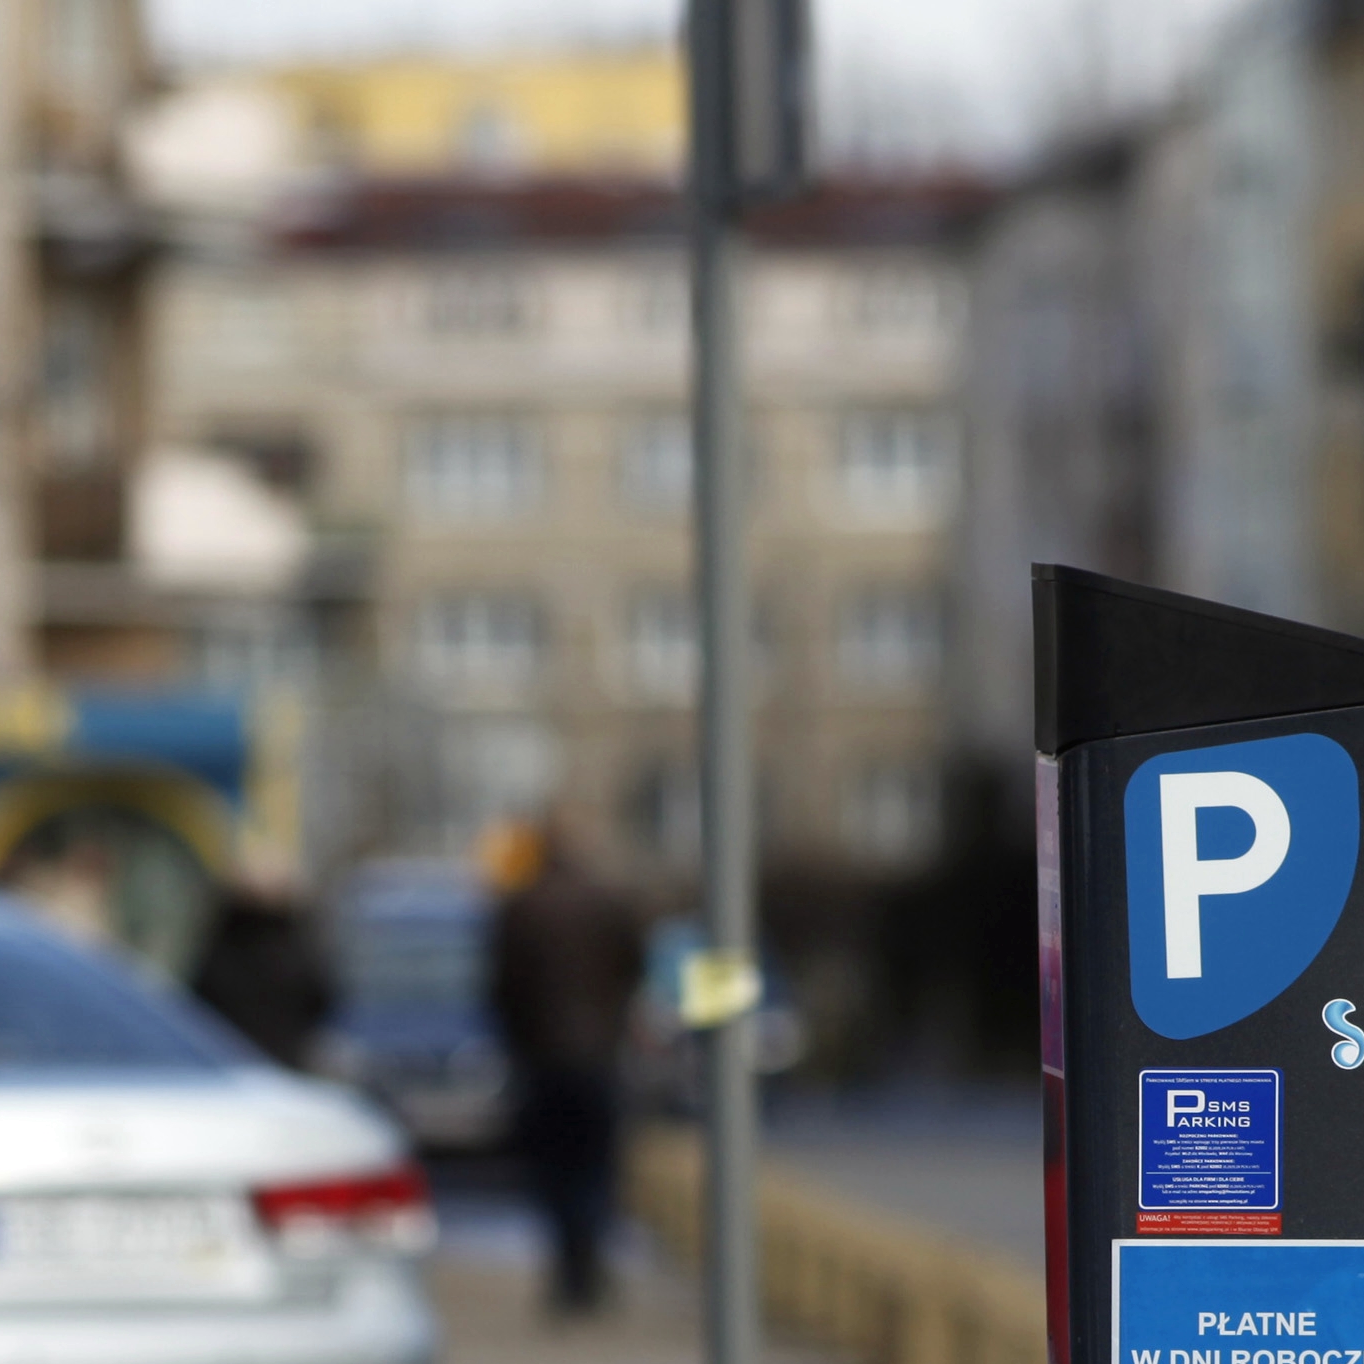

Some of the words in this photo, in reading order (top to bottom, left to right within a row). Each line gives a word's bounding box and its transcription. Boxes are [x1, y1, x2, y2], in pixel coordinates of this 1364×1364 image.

[1160, 772, 1290, 978] P
[1208, 1102, 1249, 1112] SMS
[1139, 1214, 1171, 1222] UWAGA!
[1199, 1313, 1316, 1335] PŁATNE
